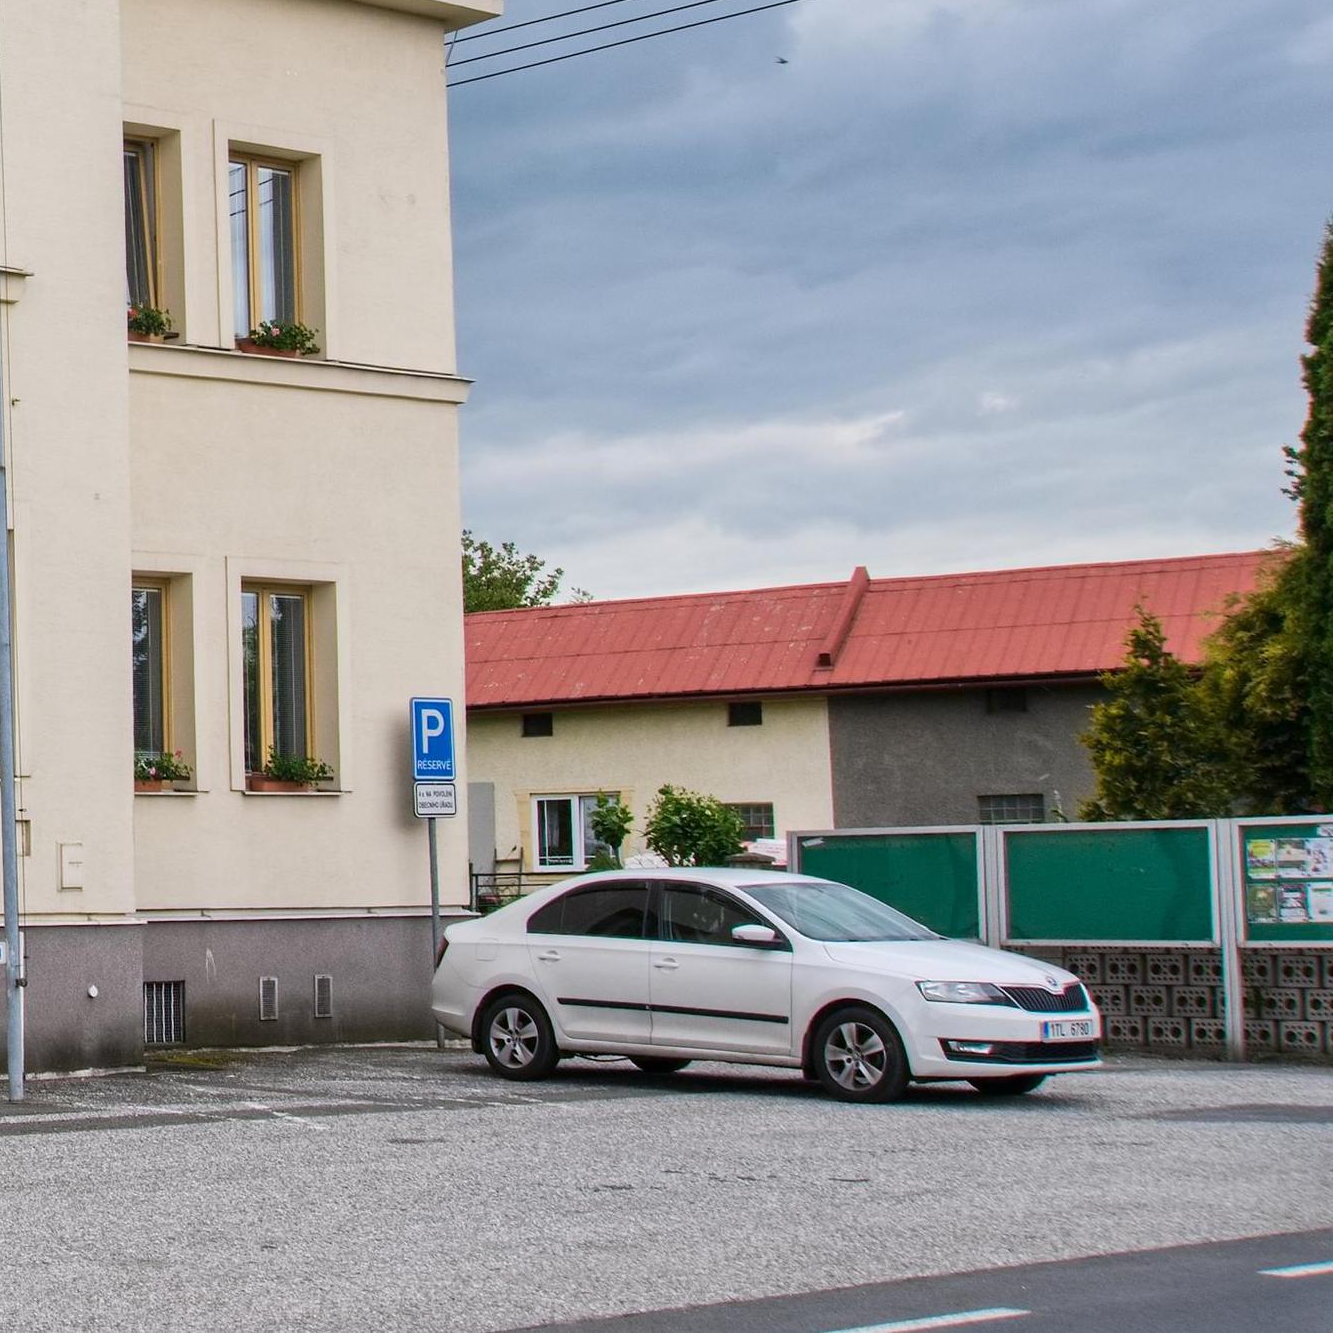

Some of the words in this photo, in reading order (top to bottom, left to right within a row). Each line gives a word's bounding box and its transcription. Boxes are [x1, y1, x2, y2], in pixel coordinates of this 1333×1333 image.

[421, 709, 445, 754] P
[417, 758, 452, 771] RÉSERVÉ
[1051, 1023, 1065, 1037] 1TL
